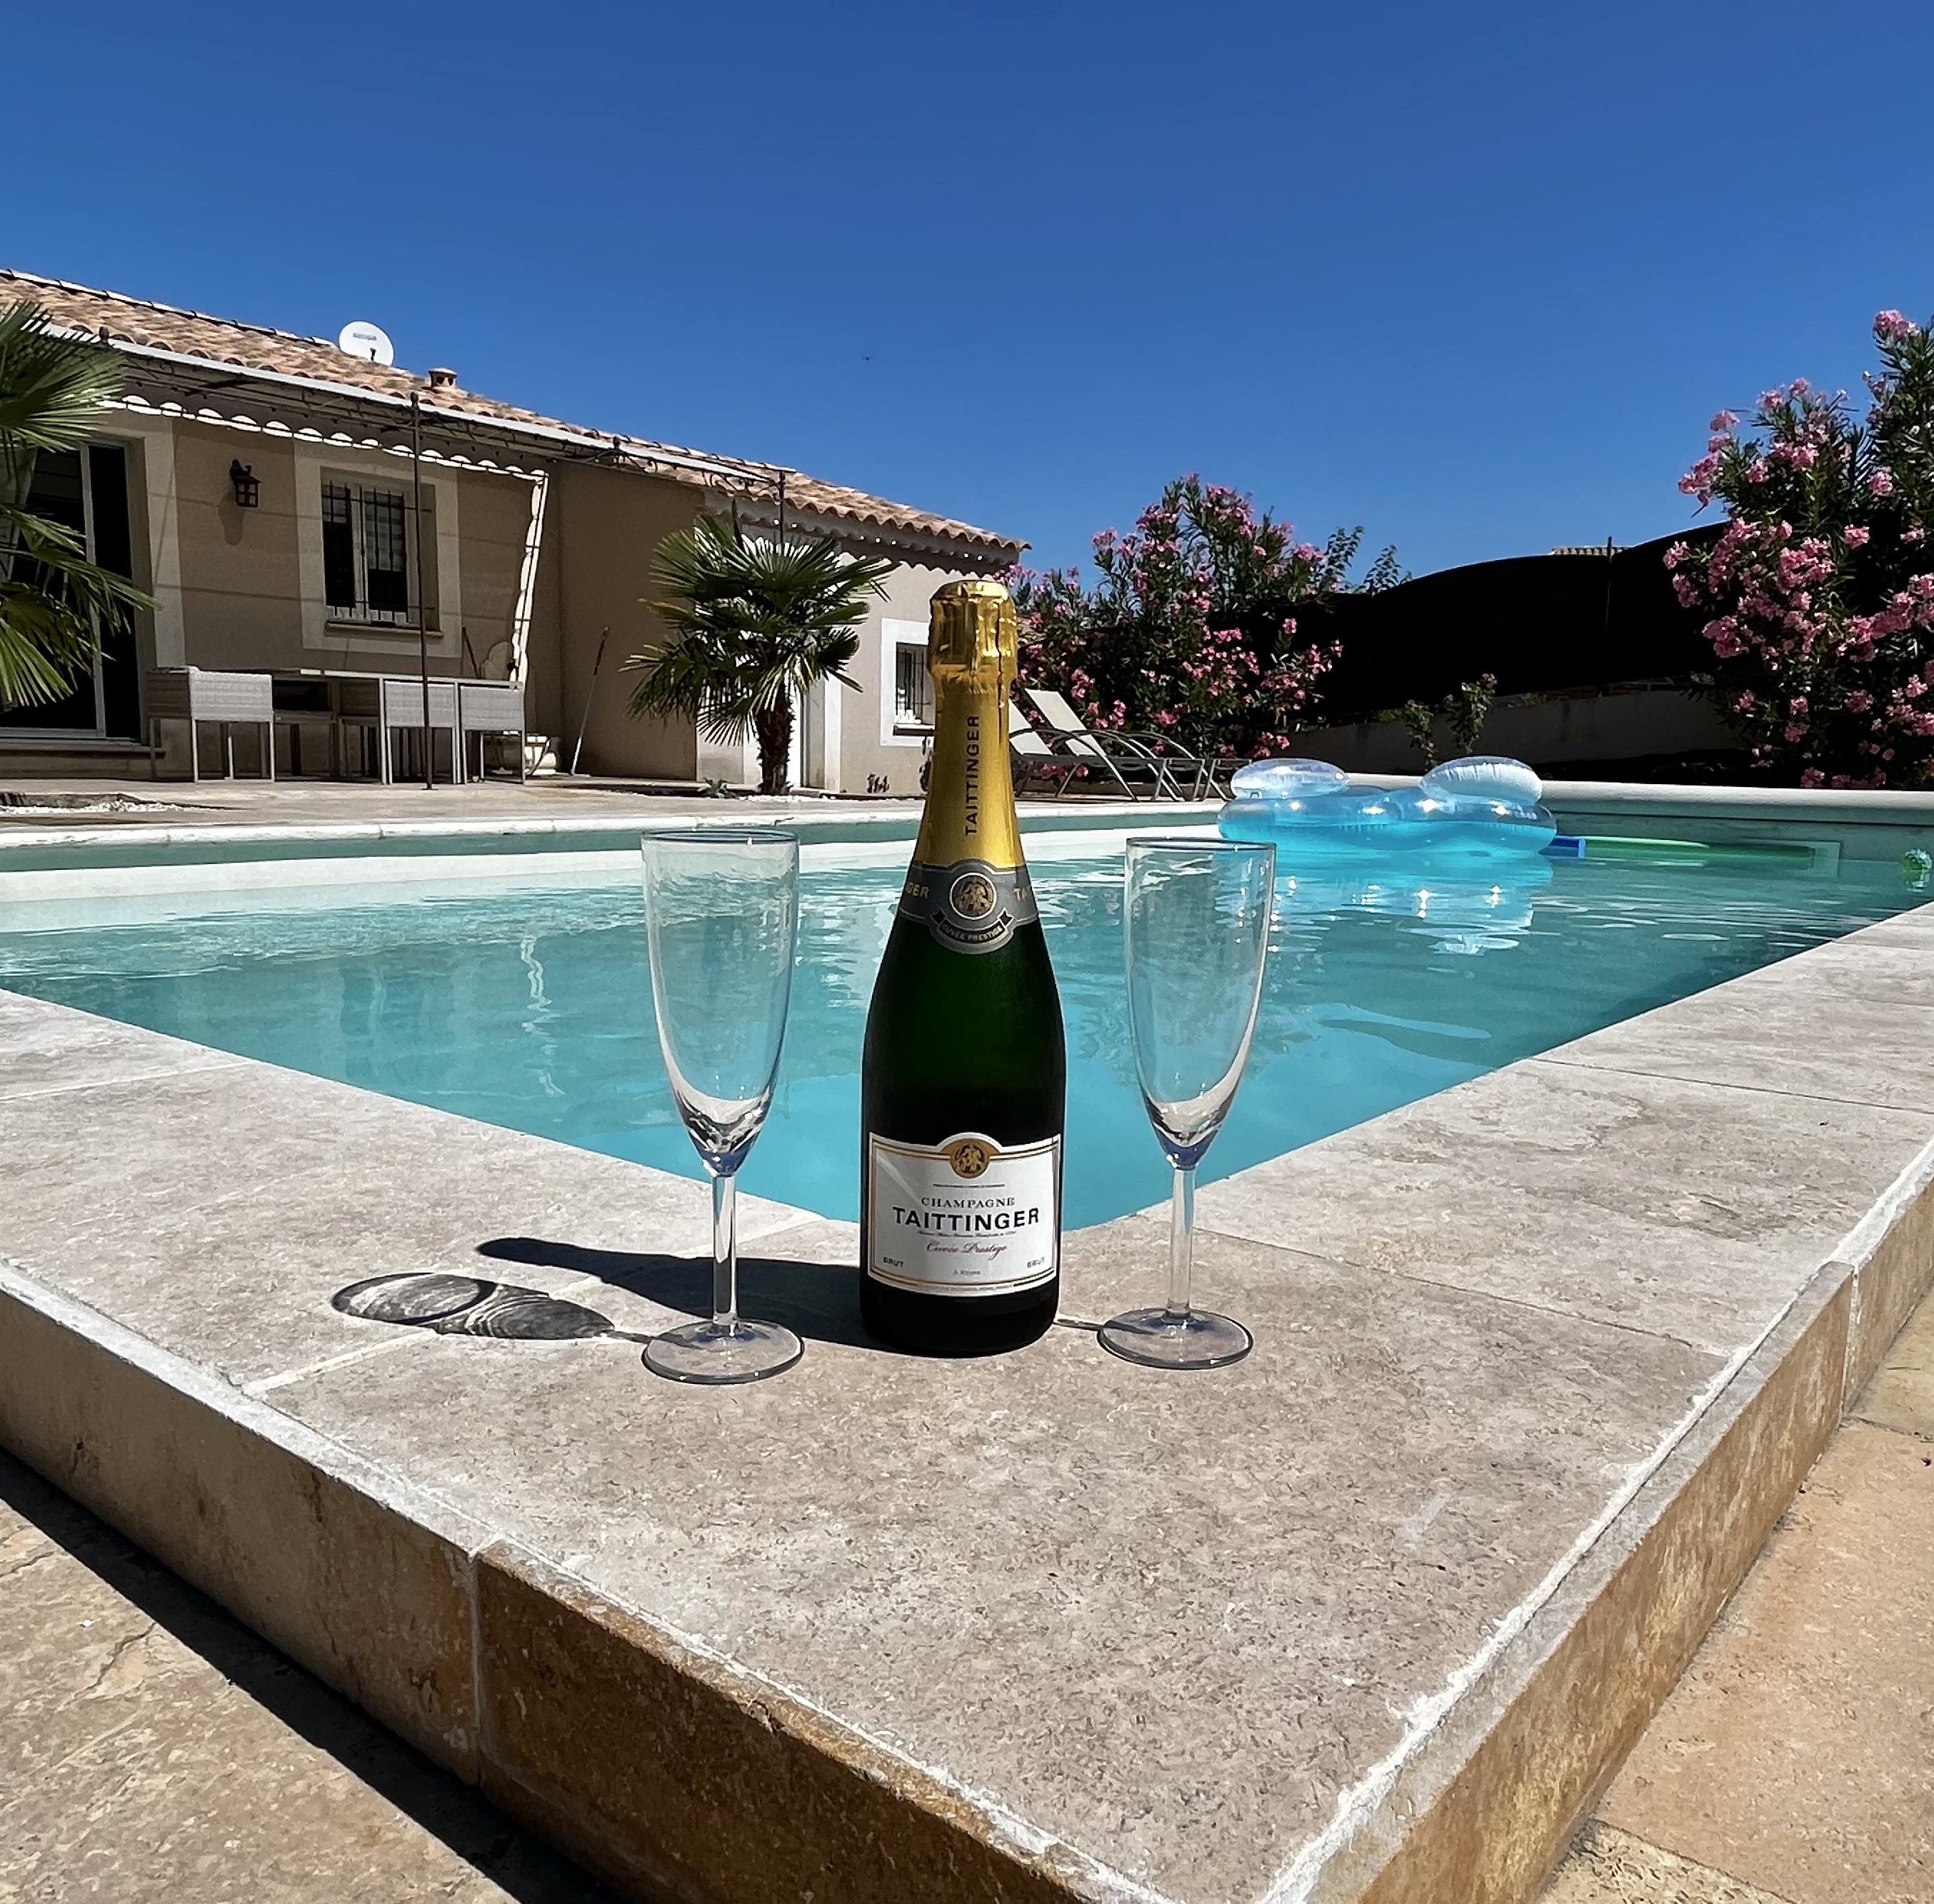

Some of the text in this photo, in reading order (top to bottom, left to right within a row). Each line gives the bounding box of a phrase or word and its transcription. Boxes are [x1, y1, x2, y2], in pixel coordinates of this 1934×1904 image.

[966, 716, 980, 836] TAITTINGER
[921, 1197, 1016, 1208] CHAMPAGNE
[892, 1206, 1039, 1231] TAITTINGER
[961, 1241, 1008, 1261] Prestige
[883, 1256, 904, 1268] BRUT
[1027, 1256, 1045, 1268] BRUT
